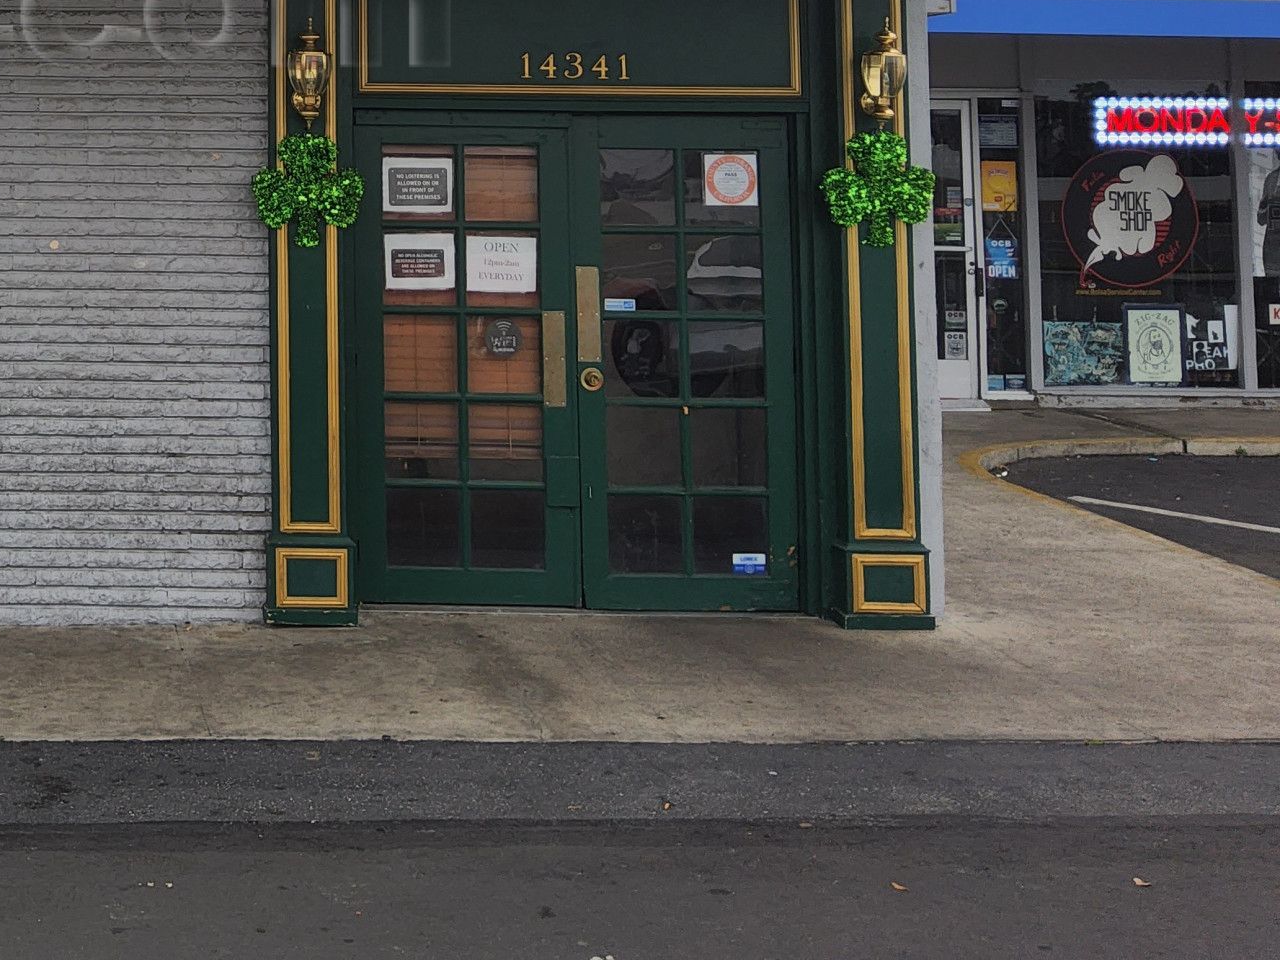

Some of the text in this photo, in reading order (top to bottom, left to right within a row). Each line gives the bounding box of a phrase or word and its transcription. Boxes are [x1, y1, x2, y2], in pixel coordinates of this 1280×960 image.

[521, 52, 630, 80] 14341
[1109, 191, 1151, 211] SMOKE
[1120, 212, 1152, 231] SHOP
[484, 242, 520, 253] OPEN
[478, 272, 524, 281] EVERYDAY
[988, 265, 1016, 277] OPEN
[1135, 312, 1175, 326] ZIG-ZAG
